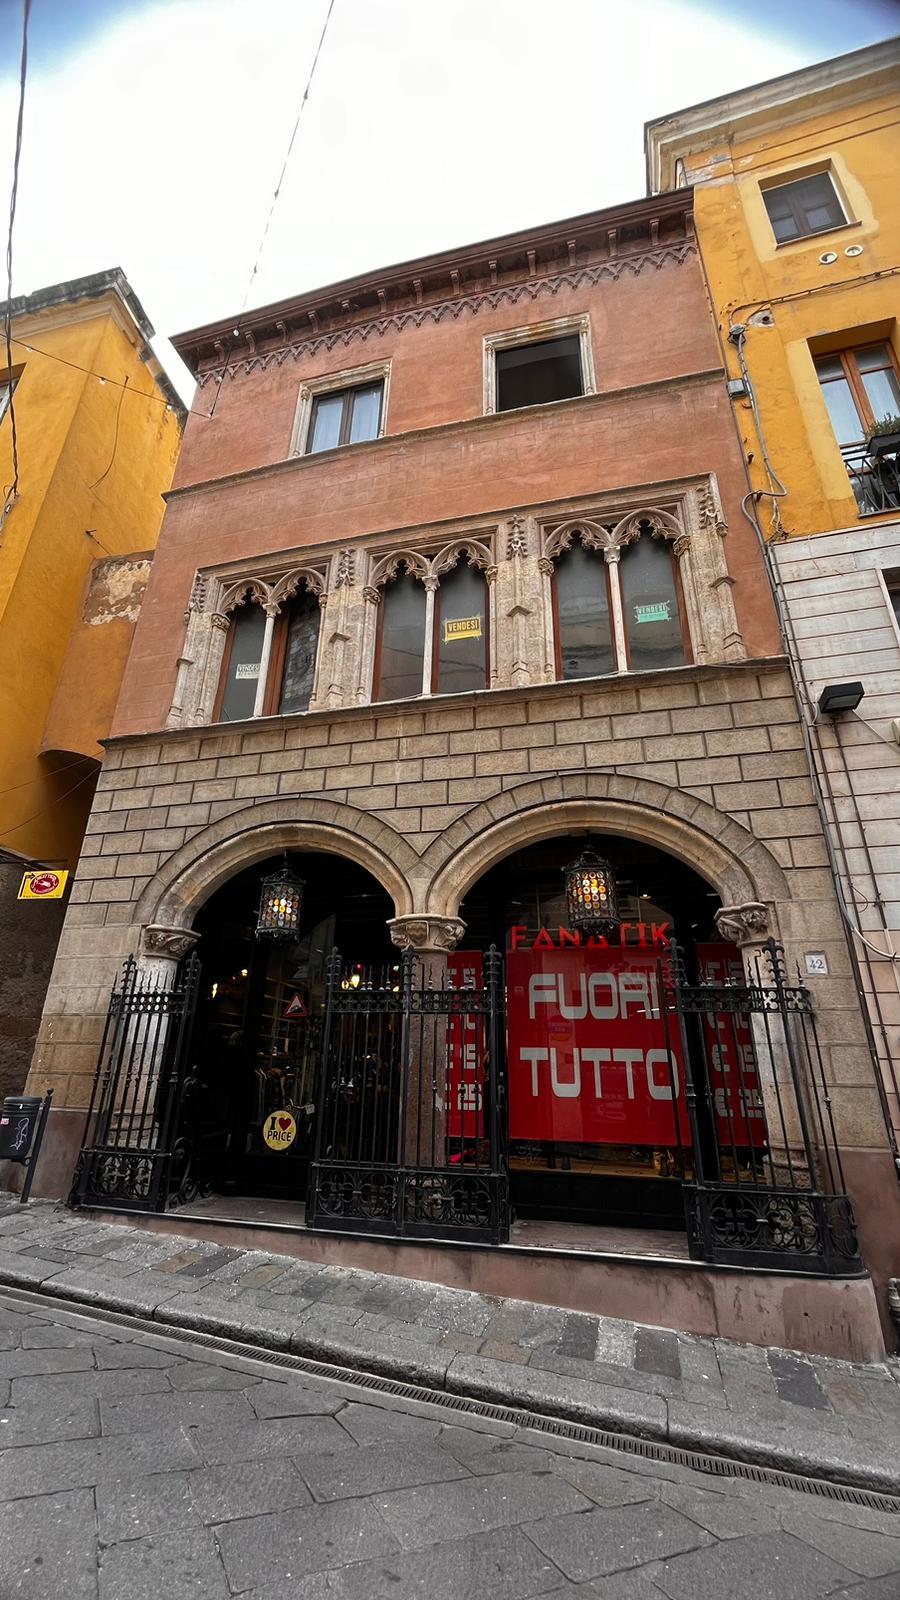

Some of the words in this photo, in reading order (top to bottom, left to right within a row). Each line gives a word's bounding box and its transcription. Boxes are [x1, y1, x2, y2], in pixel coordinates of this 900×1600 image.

[448, 620, 478, 632] VENDESI
[810, 959, 824, 969] 42
[528, 972, 660, 1020] FUORI
[519, 1047, 680, 1101] TUTTO
[267, 1130, 292, 1142] PRICE
